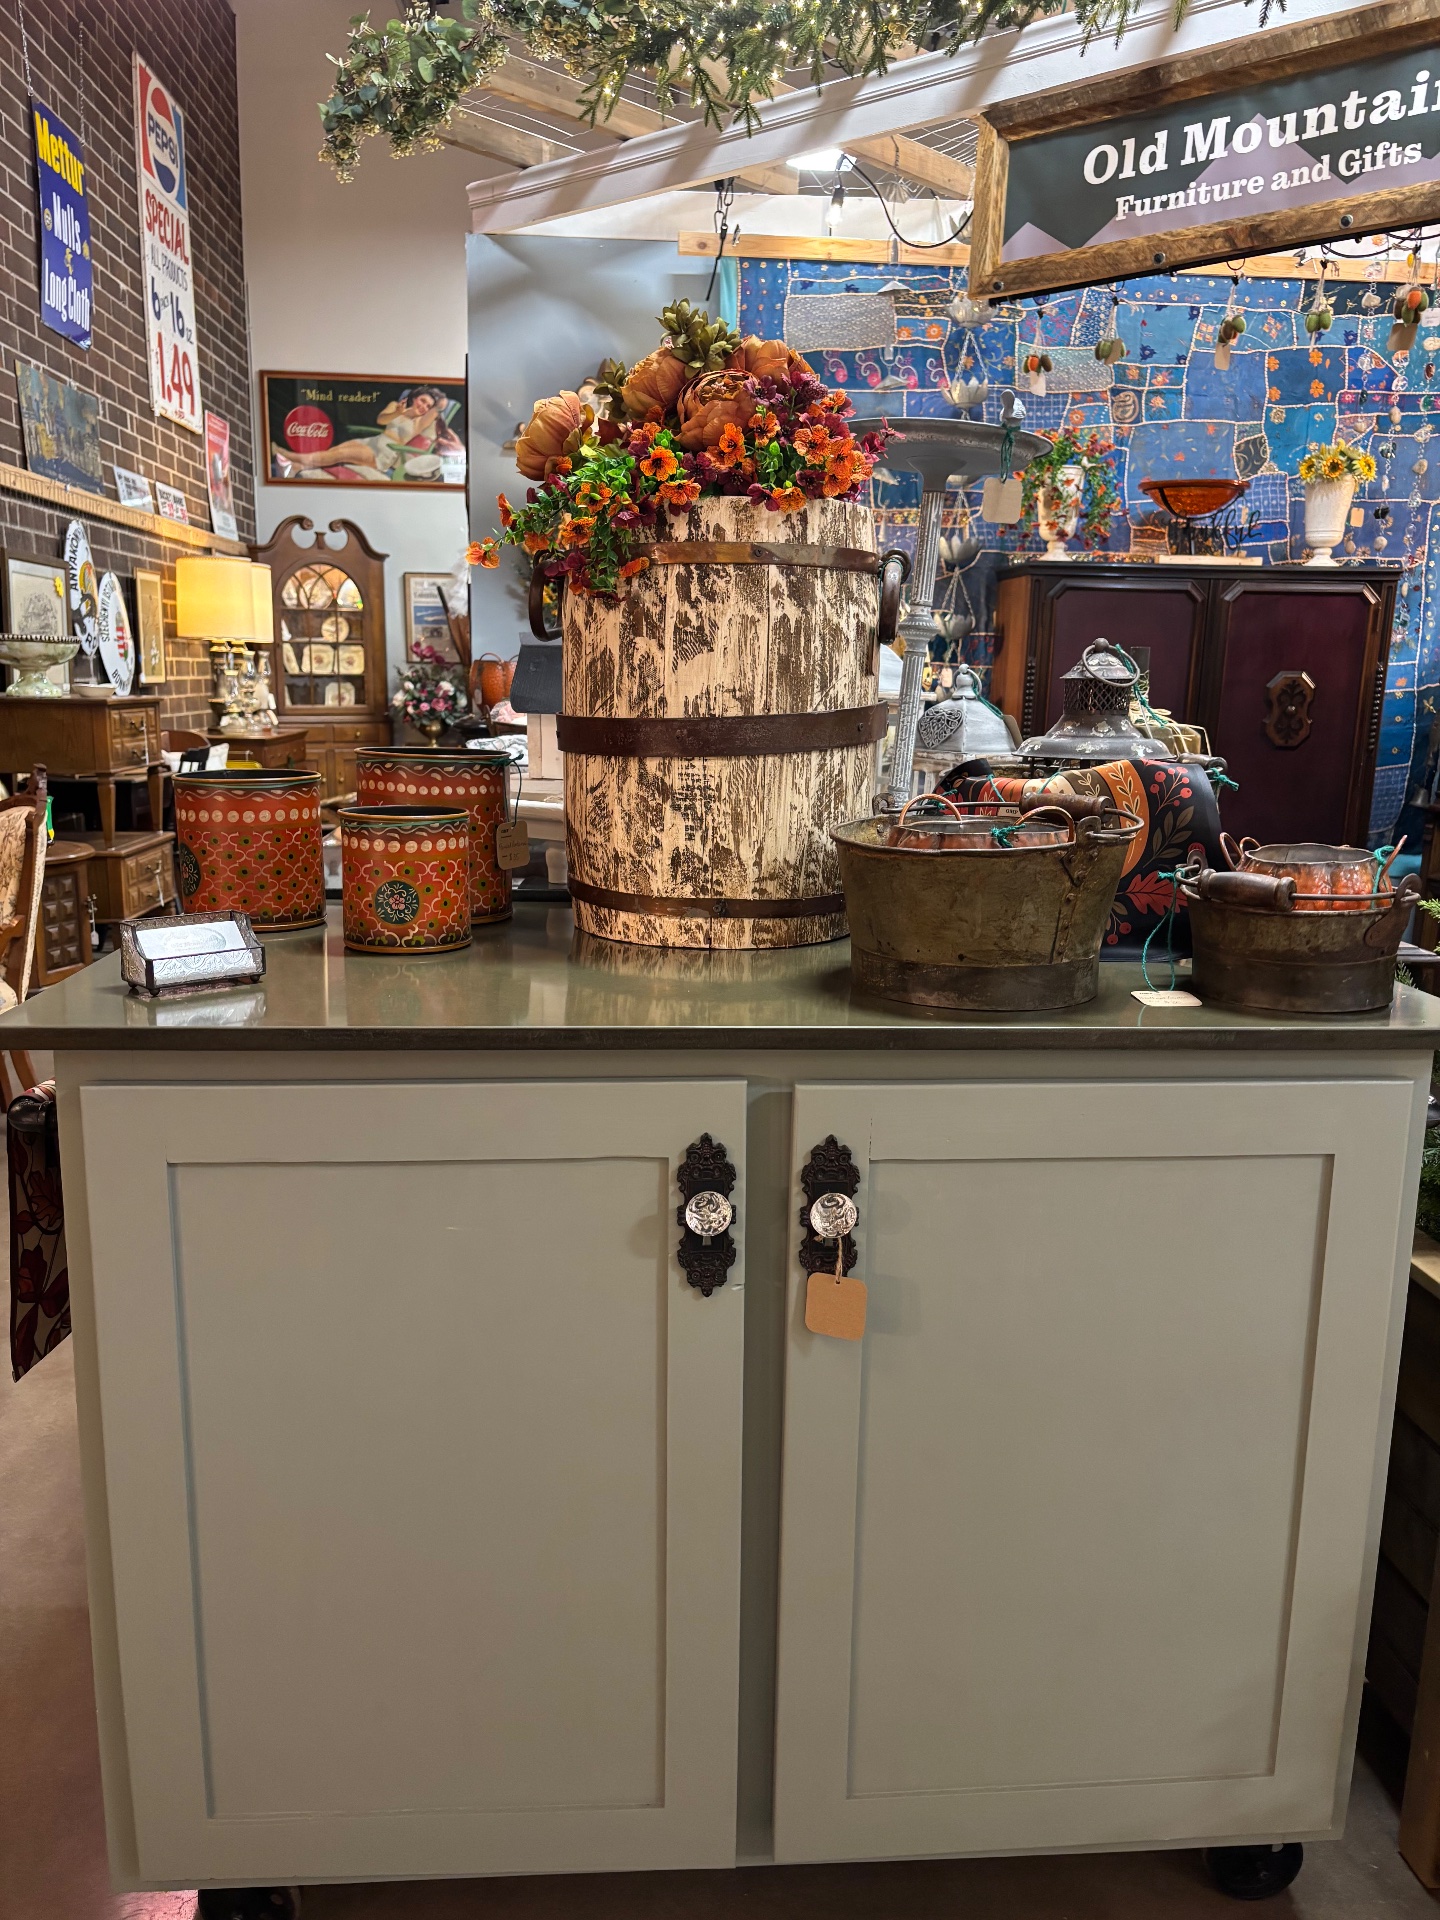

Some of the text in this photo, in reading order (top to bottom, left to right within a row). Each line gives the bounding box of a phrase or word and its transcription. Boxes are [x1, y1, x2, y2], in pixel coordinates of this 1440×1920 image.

[35, 110, 84, 196] Mettur
[148, 111, 178, 168] PEPSI
[1083, 70, 1440, 185] Old Mountai
[1115, 141, 1422, 221] Furniture and Gifts
[53, 191, 81, 255] Mulls
[145, 188, 189, 266] SPECIAL
[45, 258, 90, 332] Long Cloth
